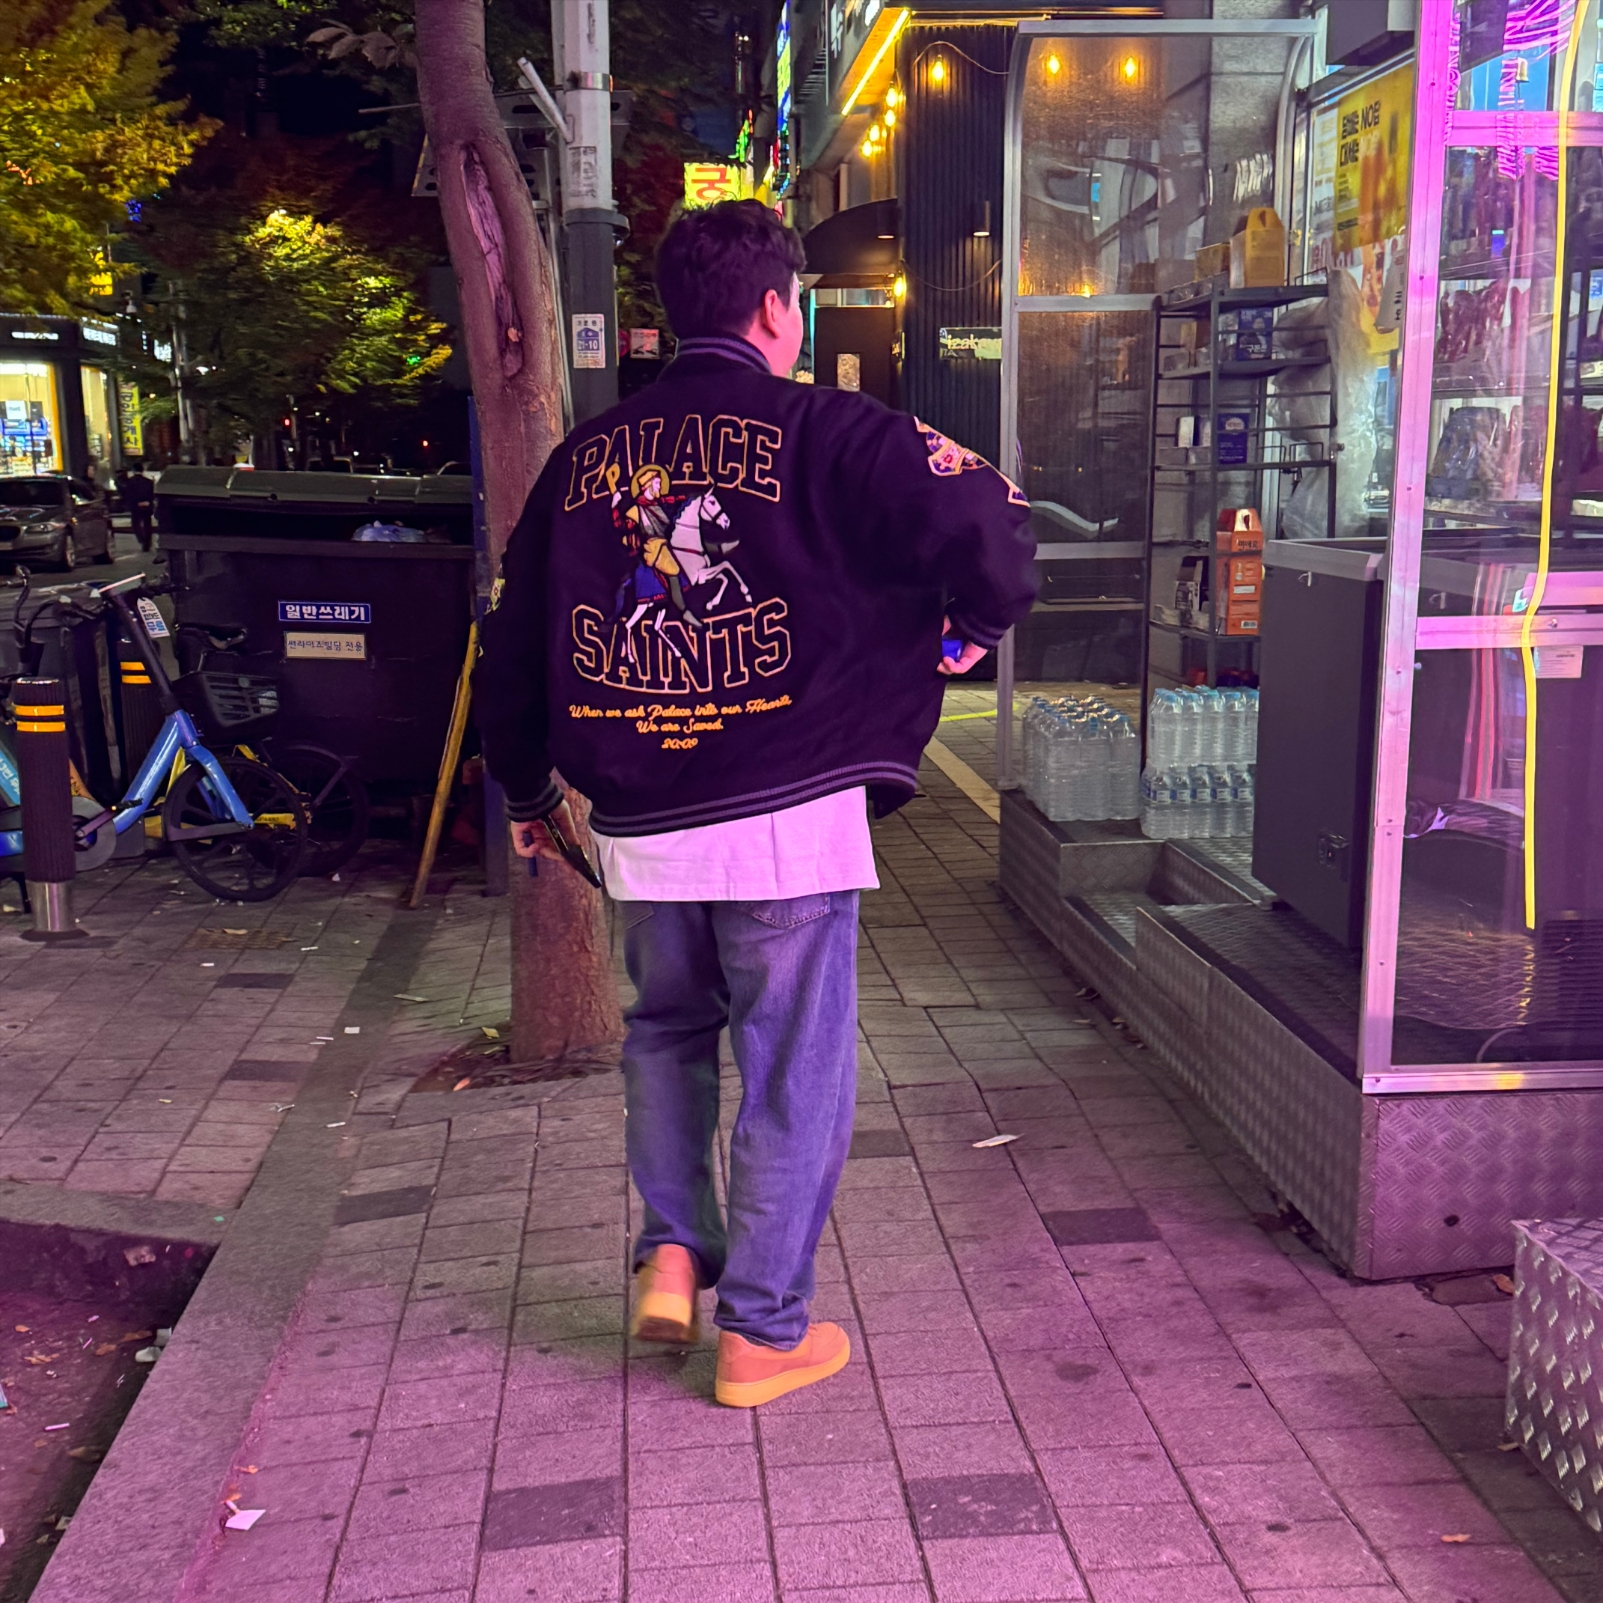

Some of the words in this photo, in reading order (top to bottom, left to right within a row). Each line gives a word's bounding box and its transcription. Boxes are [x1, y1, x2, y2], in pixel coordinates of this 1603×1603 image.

[565, 414, 782, 511] PALACE
[285, 604, 365, 621] 일반쓰레기
[572, 597, 791, 694] SAINTS
[568, 704, 604, 719] When
[605, 708, 622, 718] we
[624, 704, 646, 718] ask
[647, 704, 692, 721] Palace
[694, 702, 718, 716] into
[720, 704, 742, 715] our
[636, 719, 659, 734] We
[660, 721, 680, 732] are
